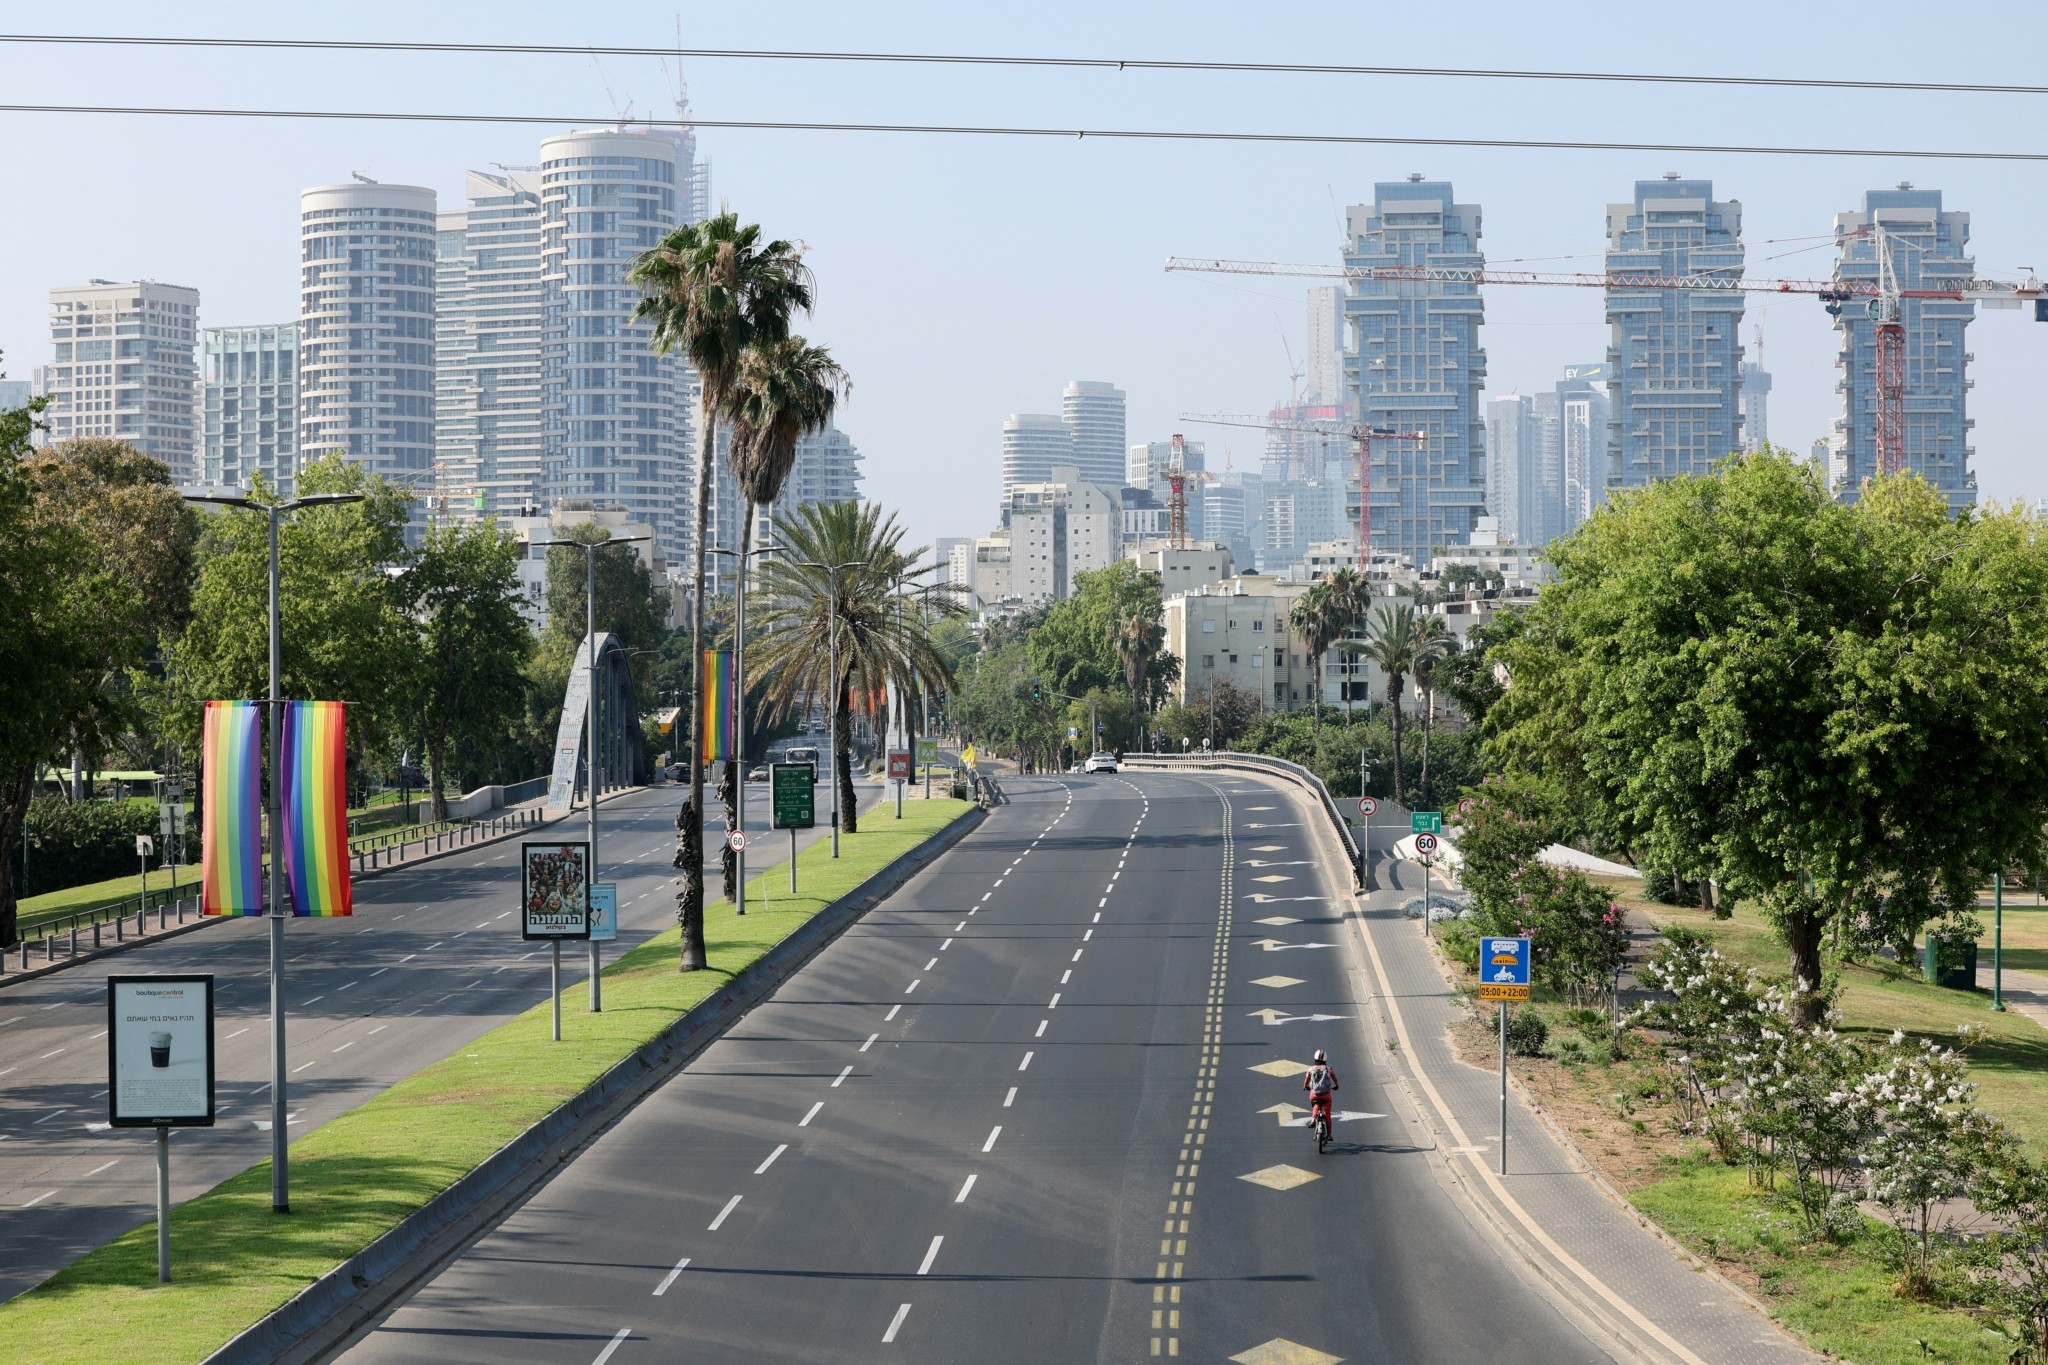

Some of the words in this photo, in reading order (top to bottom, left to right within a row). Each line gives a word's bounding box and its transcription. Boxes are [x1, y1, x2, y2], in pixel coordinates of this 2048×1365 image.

[1565, 368, 1579, 378] EY
[733, 836, 742, 846] 60
[1419, 838, 1434, 849] 60
[530, 913, 582, 924] החתונה
[1481, 987, 1501, 996] 05:00
[1507, 988, 1528, 997] 22:00
